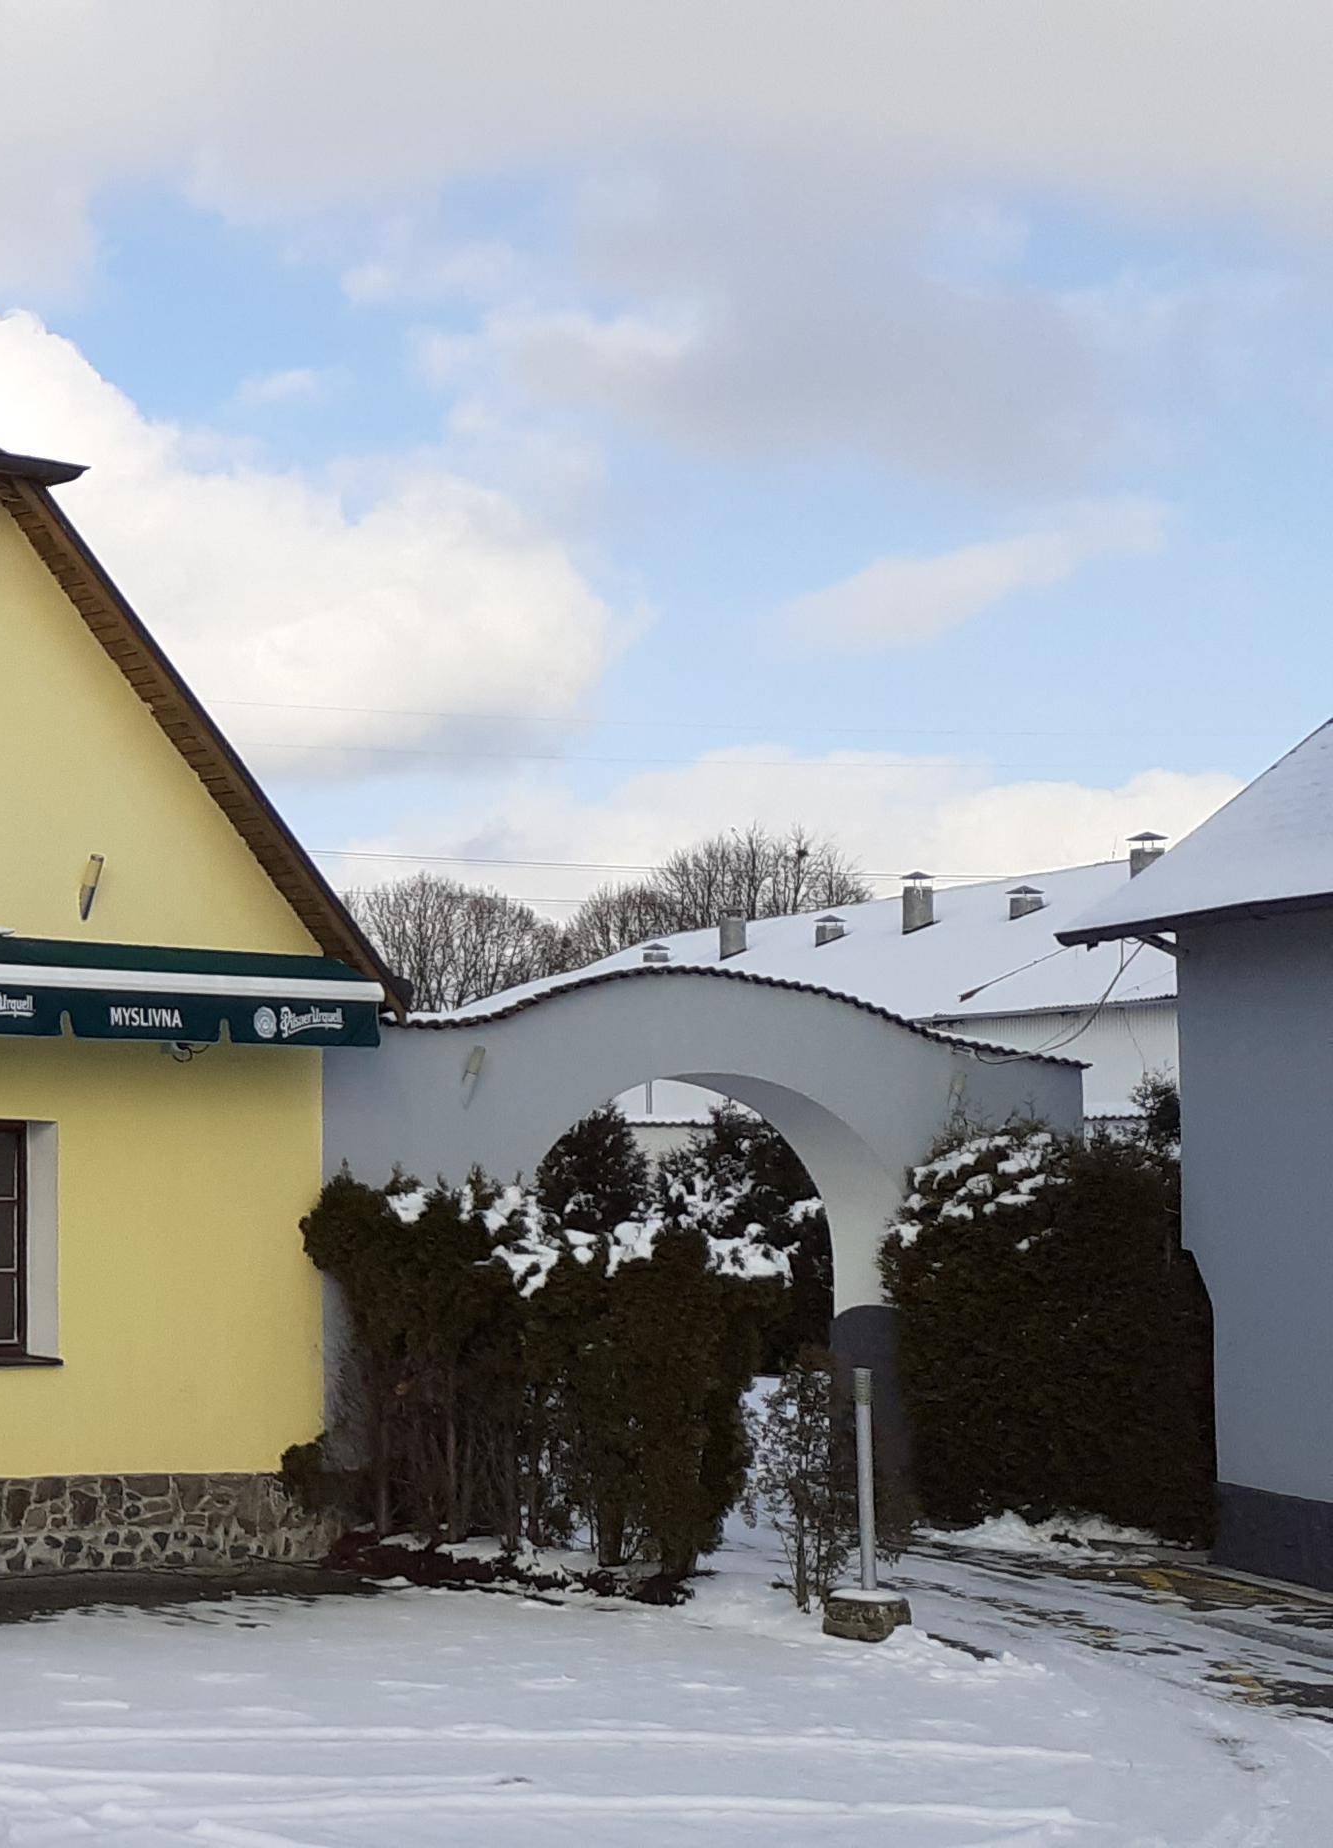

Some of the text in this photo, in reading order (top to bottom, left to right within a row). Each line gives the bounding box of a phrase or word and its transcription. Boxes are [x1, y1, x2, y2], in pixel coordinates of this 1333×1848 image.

[109, 1006, 183, 1029] MYSLIVNA
[279, 1007, 345, 1038] Pilsner Urquell
